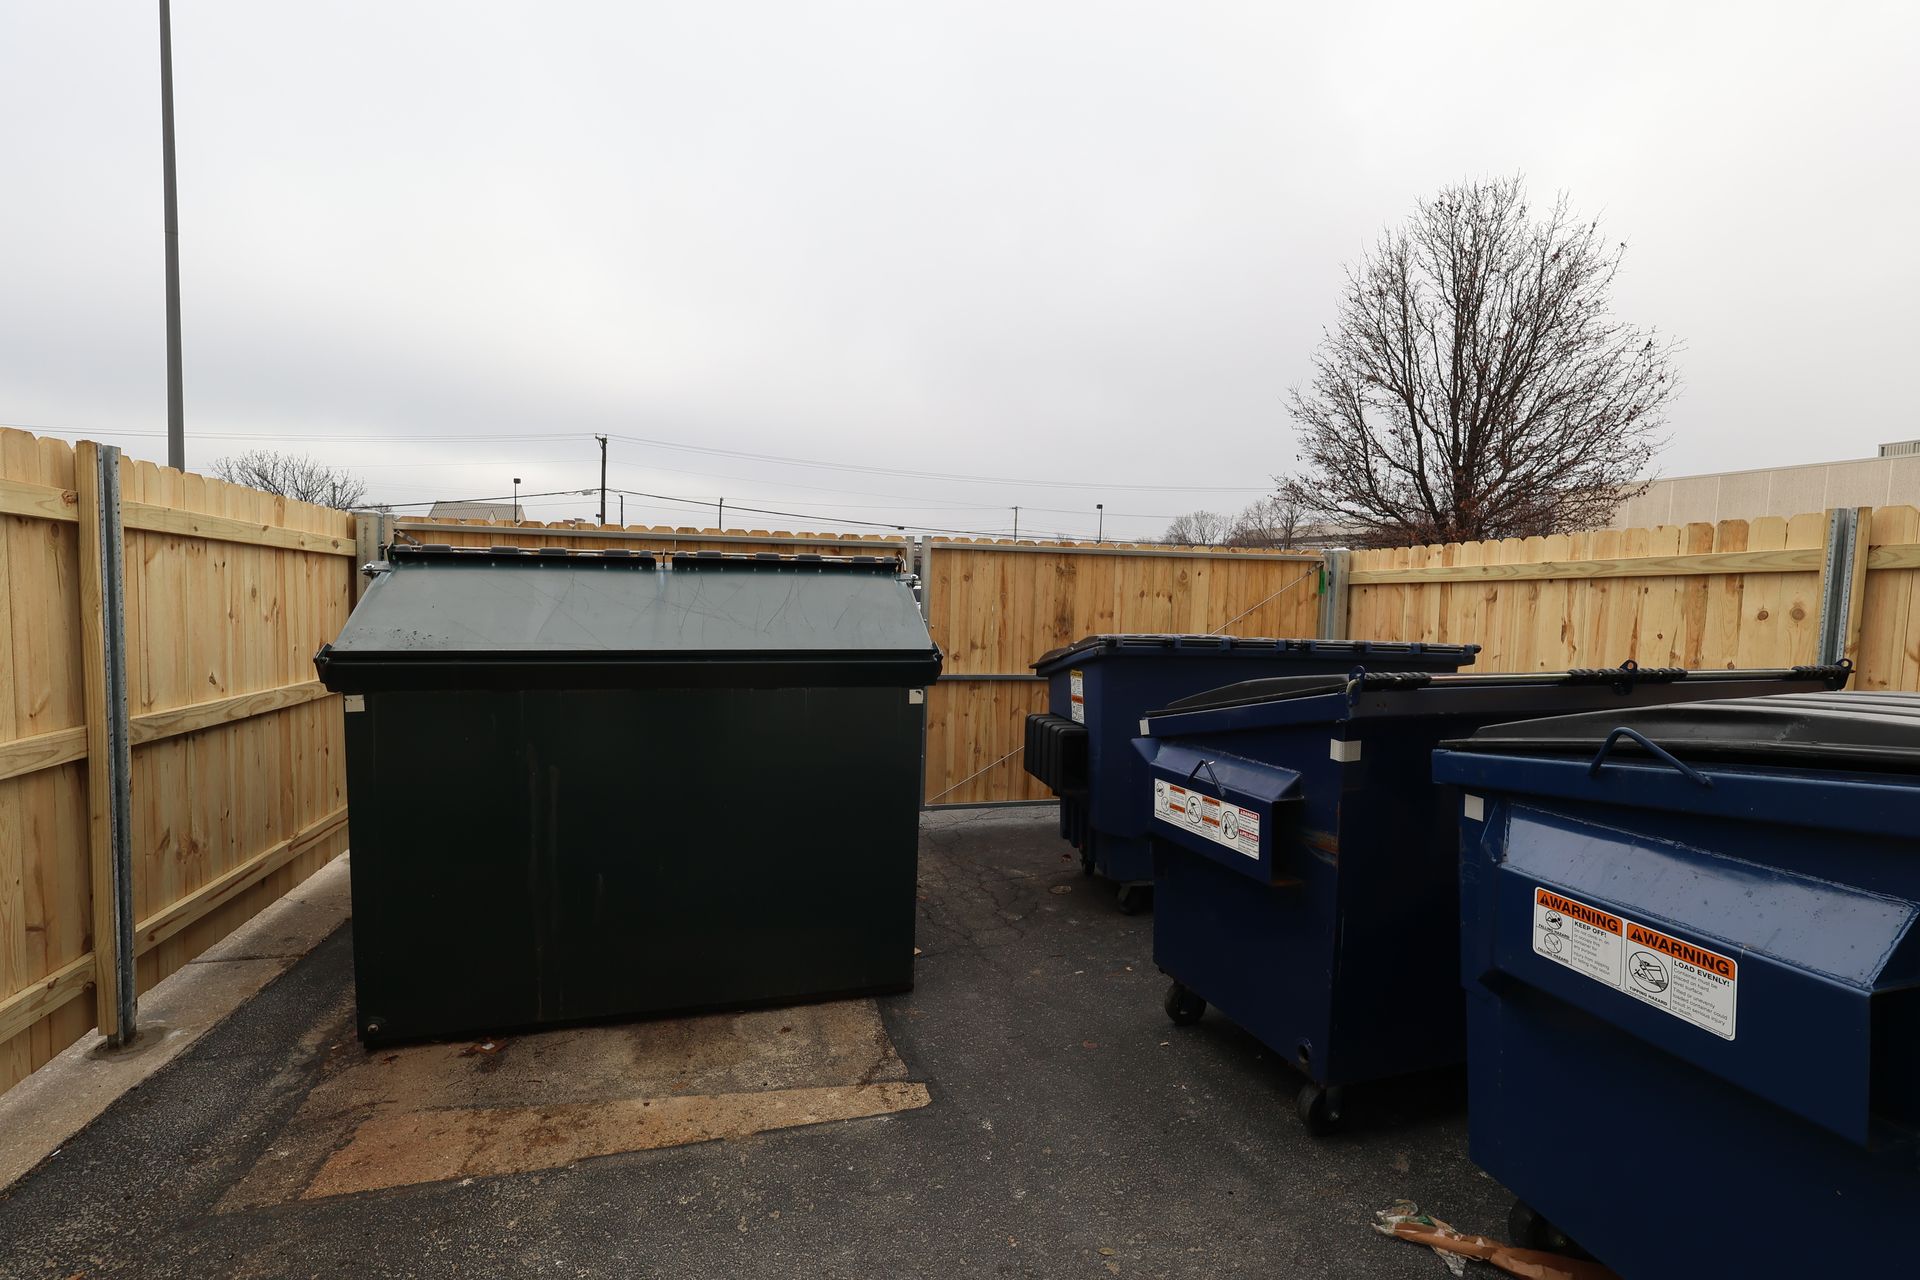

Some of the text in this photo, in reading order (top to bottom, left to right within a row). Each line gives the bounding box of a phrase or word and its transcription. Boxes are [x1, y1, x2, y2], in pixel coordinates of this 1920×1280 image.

[1243, 810, 1257, 819] DANGER
[1549, 895, 1618, 932] WARNING
[1538, 923, 1569, 939] FALLING HAZARD
[1574, 920, 1606, 937] KEEP OFF!
[1537, 946, 1568, 963] FALLING HAZARD
[1642, 929, 1729, 976] WARNING
[1674, 959, 1729, 987] LOAD EVENLY!
[1629, 985, 1647, 997] TIPPING
[1648, 994, 1667, 1006] HAZARD
